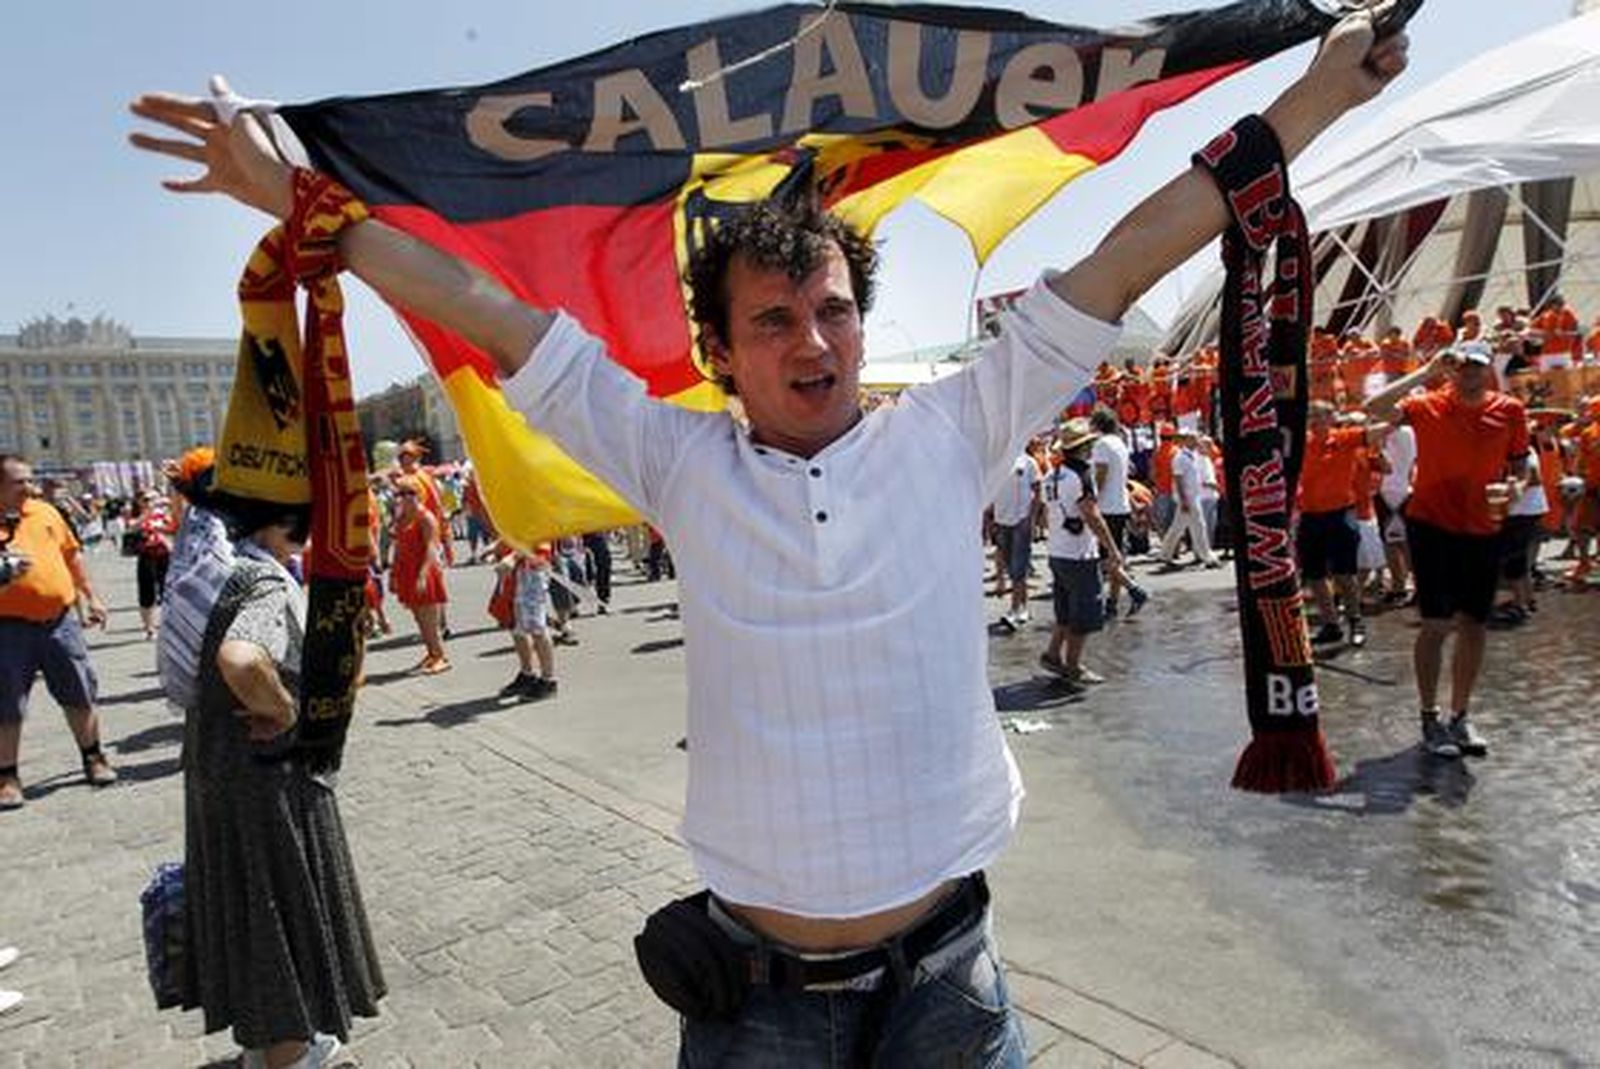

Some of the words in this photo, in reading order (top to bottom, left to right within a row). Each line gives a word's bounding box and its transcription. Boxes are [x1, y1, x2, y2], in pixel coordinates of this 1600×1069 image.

[465, 9, 1167, 160] CALAUer
[1241, 448, 1296, 589] WIR
[1266, 672, 1319, 716] Be
